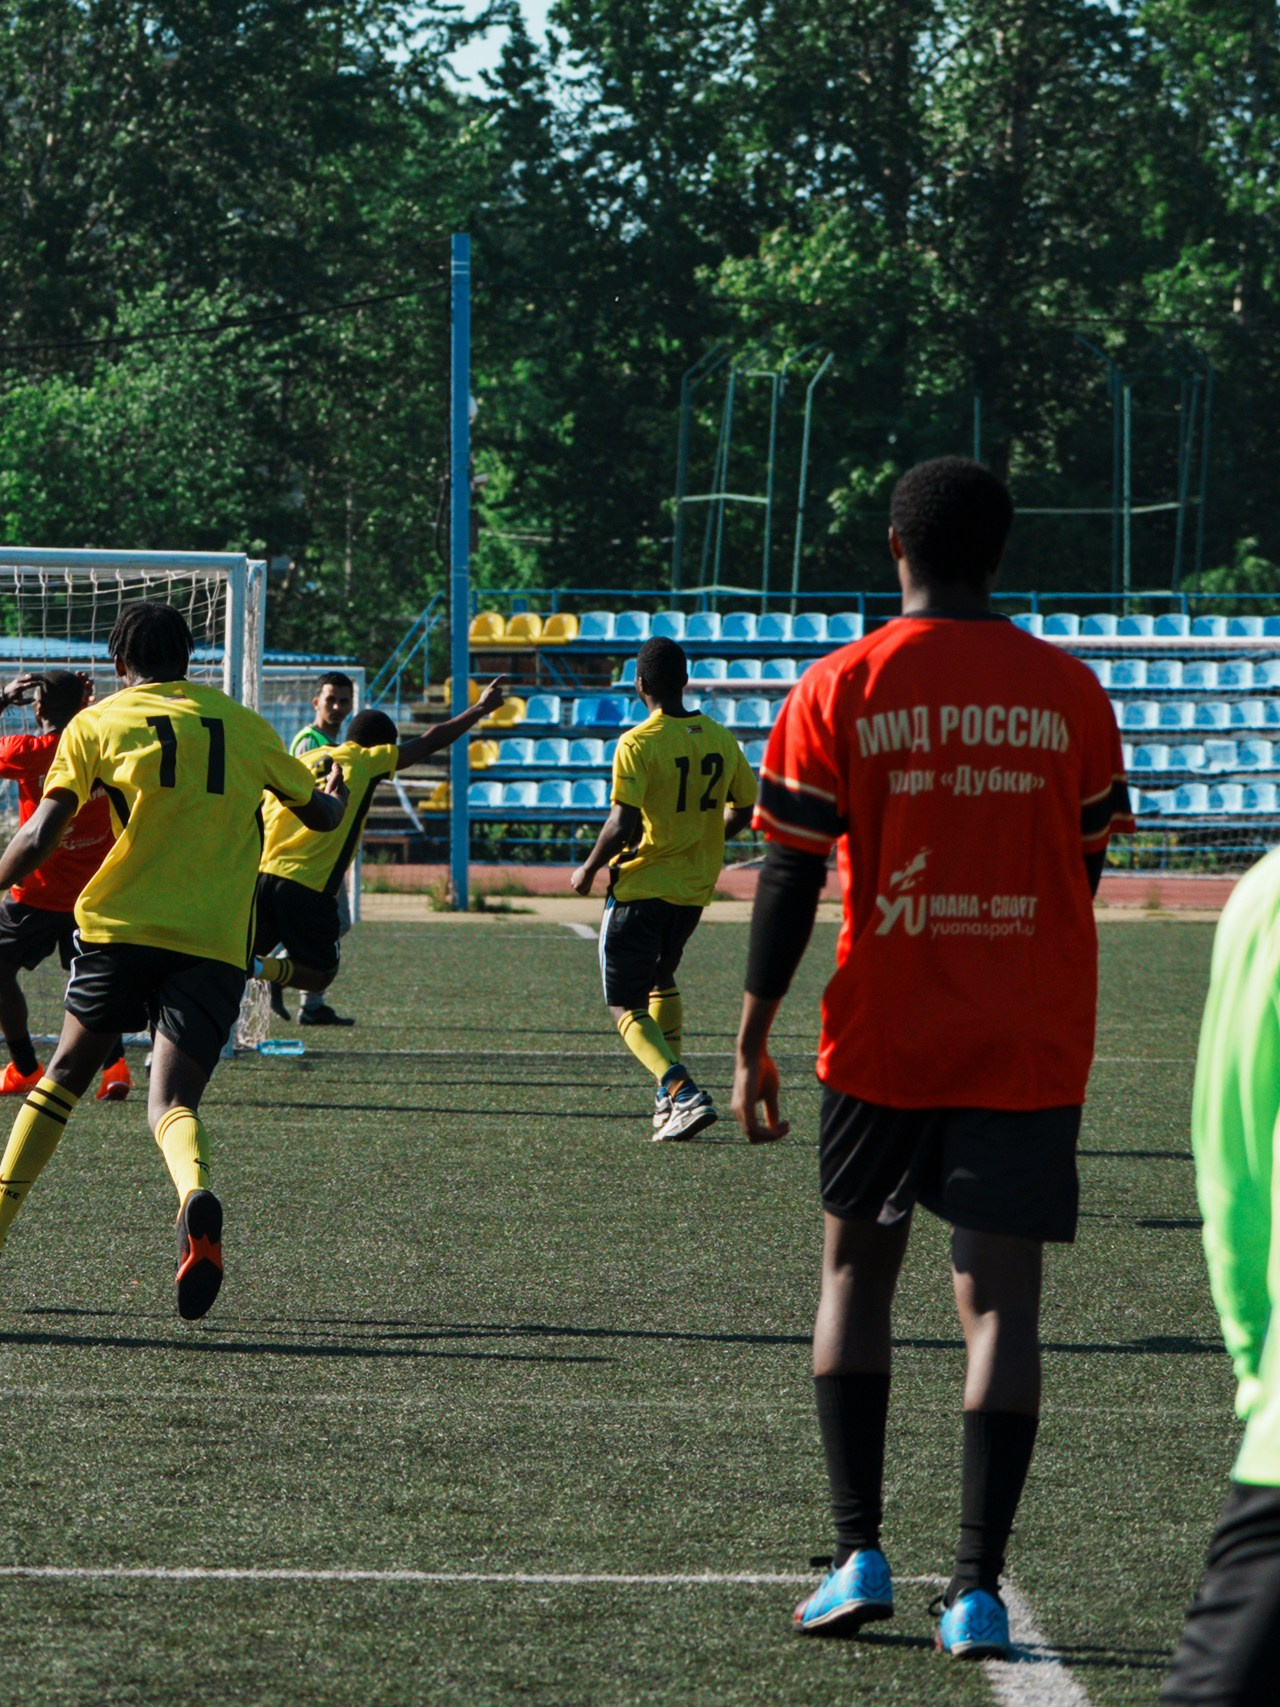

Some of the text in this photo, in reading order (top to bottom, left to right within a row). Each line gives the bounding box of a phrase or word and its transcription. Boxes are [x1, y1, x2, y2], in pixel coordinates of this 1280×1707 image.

[145, 714, 226, 795] 11
[856, 704, 1070, 758] МИД РОССИИ
[674, 752, 725, 813] 12
[930, 920, 1036, 940] yuanasport.u
